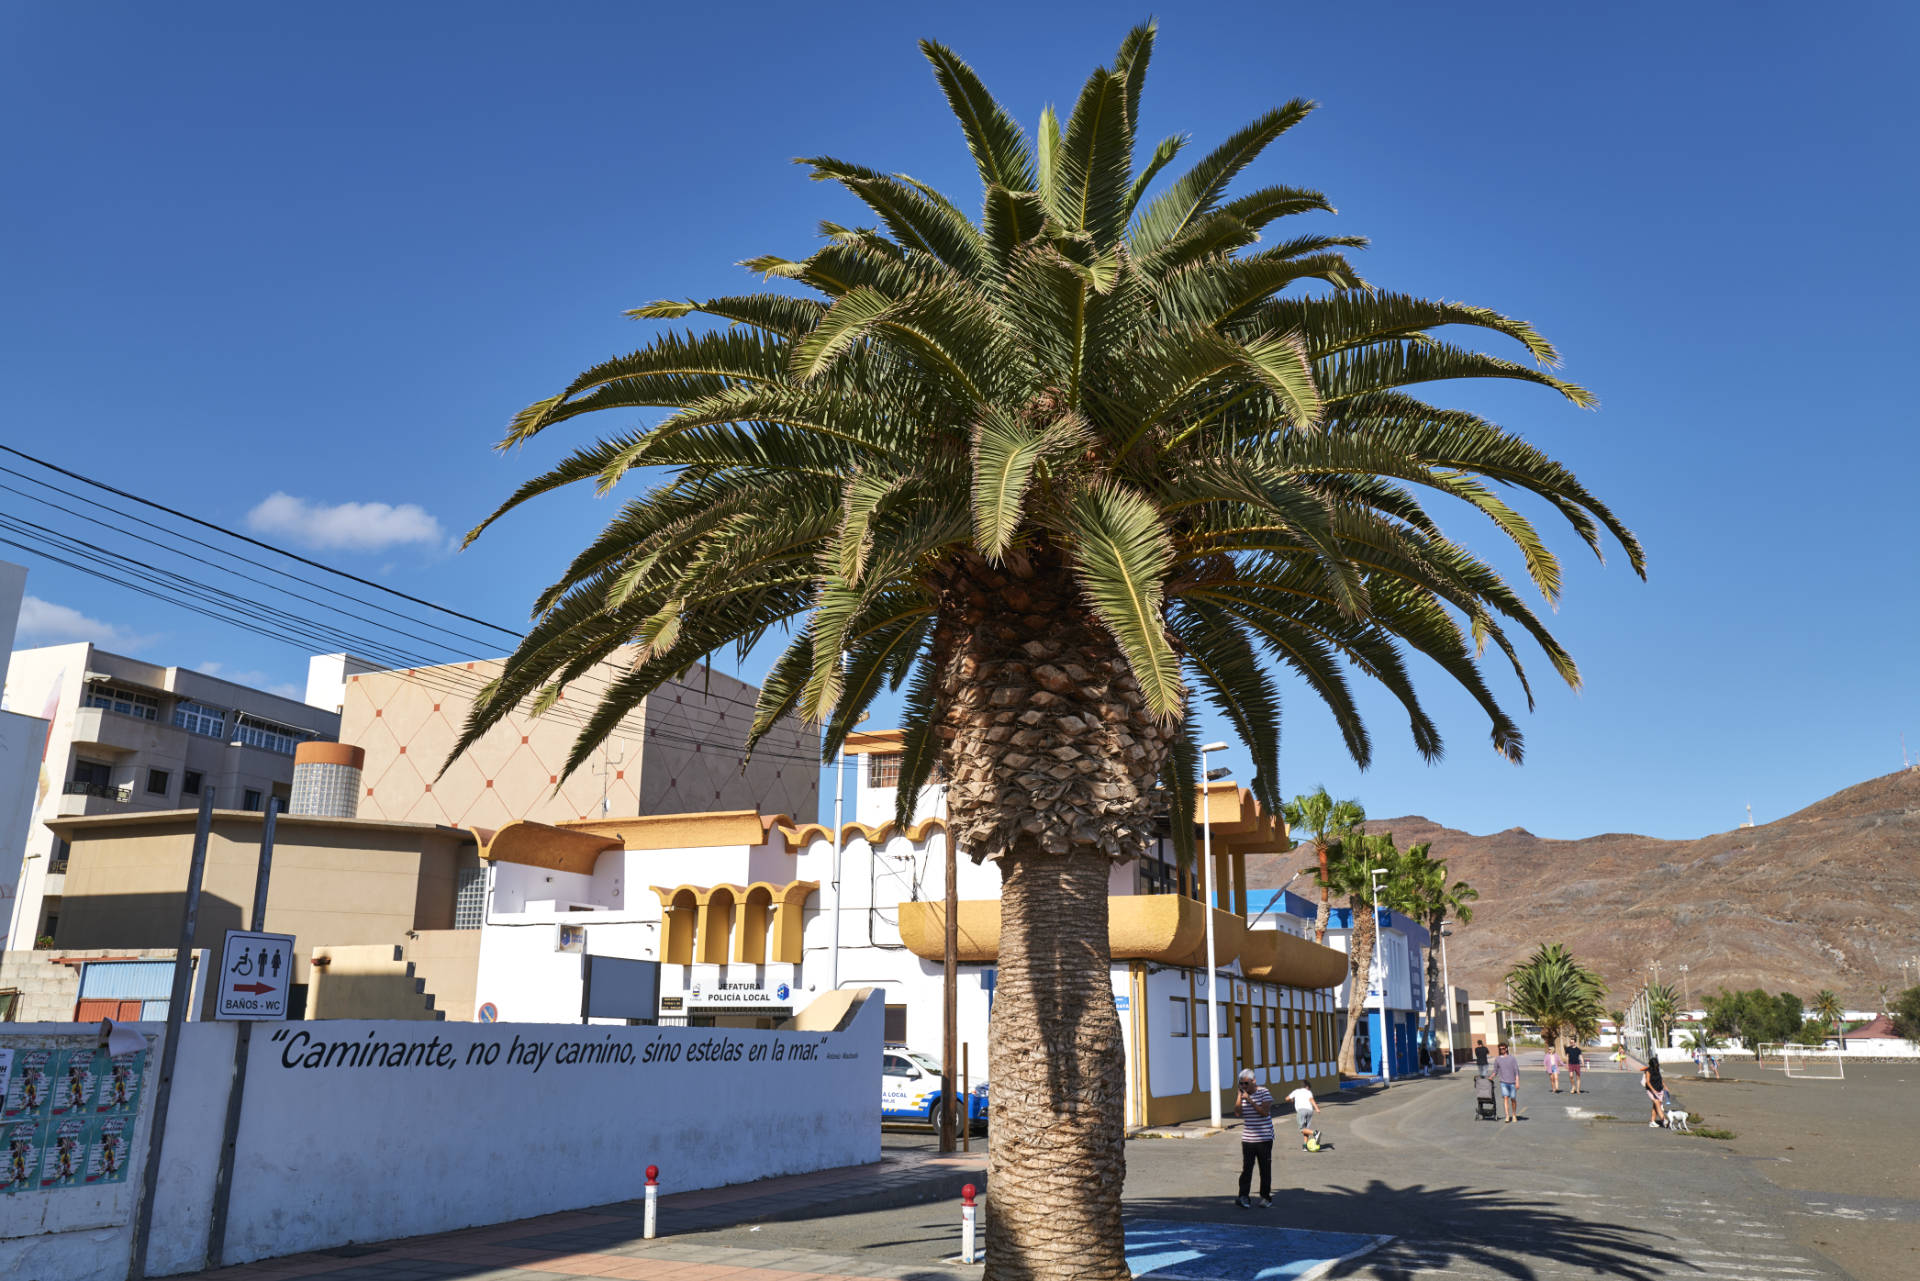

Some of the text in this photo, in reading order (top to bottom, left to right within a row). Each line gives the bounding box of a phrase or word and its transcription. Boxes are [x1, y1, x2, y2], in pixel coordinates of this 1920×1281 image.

[708, 992, 741, 1001] POLICÍA
[225, 997, 258, 1010] BAÑOS
[265, 1000, 281, 1010] WC
[271, 1028, 457, 1070] “Caminante,
[465, 1042, 501, 1066] no
[506, 1034, 554, 1074] hay
[556, 1034, 637, 1065] camino,
[641, 1034, 682, 1063] sino
[686, 1036, 744, 1063] estelas
[748, 1043, 768, 1062] en
[771, 1038, 785, 1061] la
